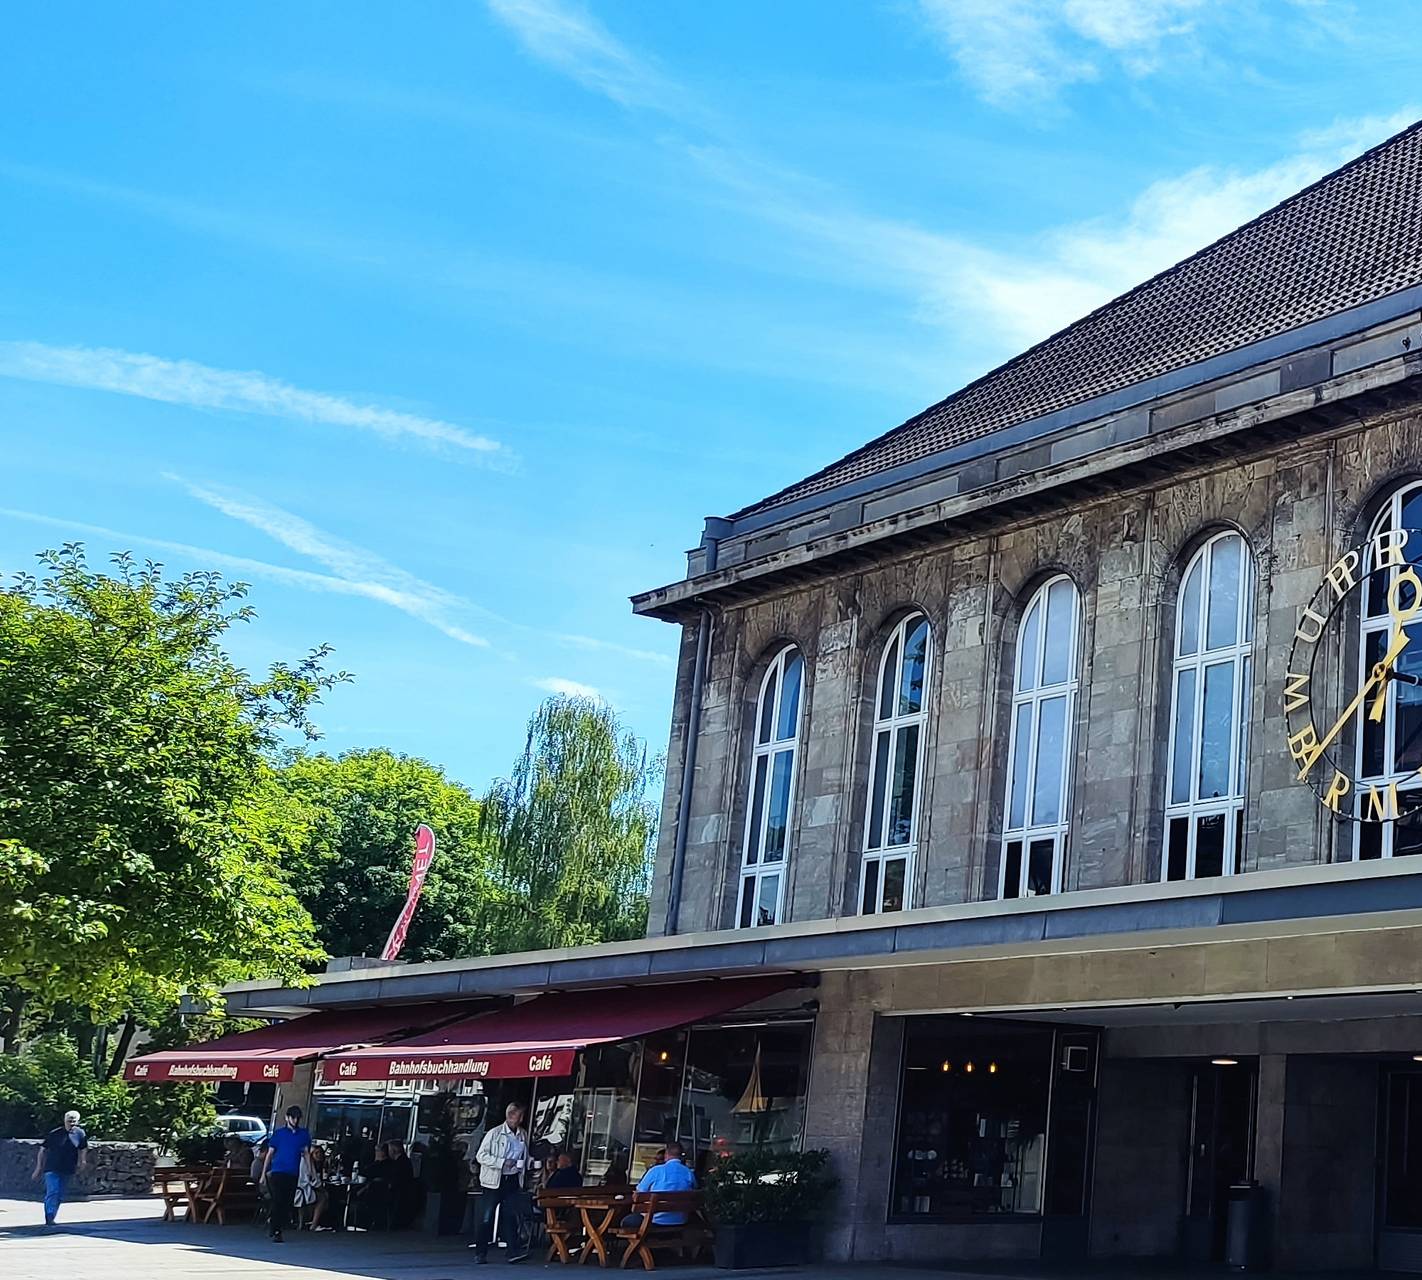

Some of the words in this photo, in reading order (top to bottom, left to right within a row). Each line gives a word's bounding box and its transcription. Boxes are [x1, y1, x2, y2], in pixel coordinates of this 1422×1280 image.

[134, 1064, 149, 1076] Café
[168, 1064, 238, 1079] Bahnhofsbuchhandlung
[263, 1064, 280, 1078] Café
[339, 1062, 358, 1076] Café
[388, 1060, 490, 1076] Bahnhofsbuchhandlung
[528, 1055, 553, 1072] Café
